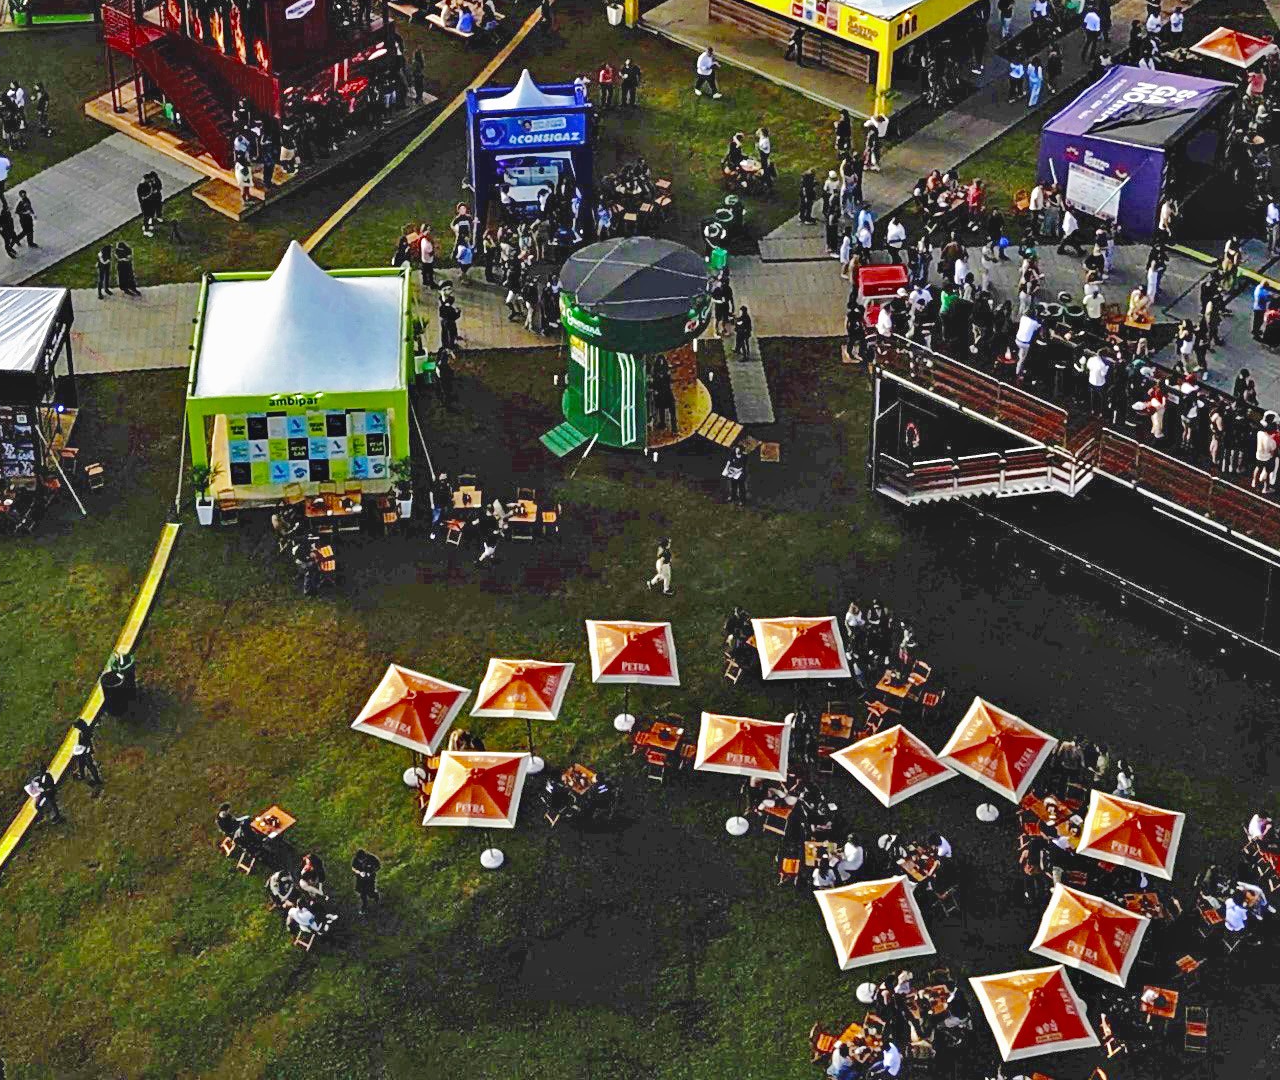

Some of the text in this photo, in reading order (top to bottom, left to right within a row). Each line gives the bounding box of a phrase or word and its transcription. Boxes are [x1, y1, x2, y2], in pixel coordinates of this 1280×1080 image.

[896, 14, 918, 41] BAR
[518, 131, 580, 144] CONSIGAZ
[268, 394, 319, 408] ambipar
[622, 661, 651, 672] PETRA
[790, 656, 821, 668] PETRA
[725, 752, 758, 766] PETRA
[455, 801, 486, 814] PETRA
[1110, 839, 1143, 859] PETRA
[1066, 938, 1098, 961] PETRA
